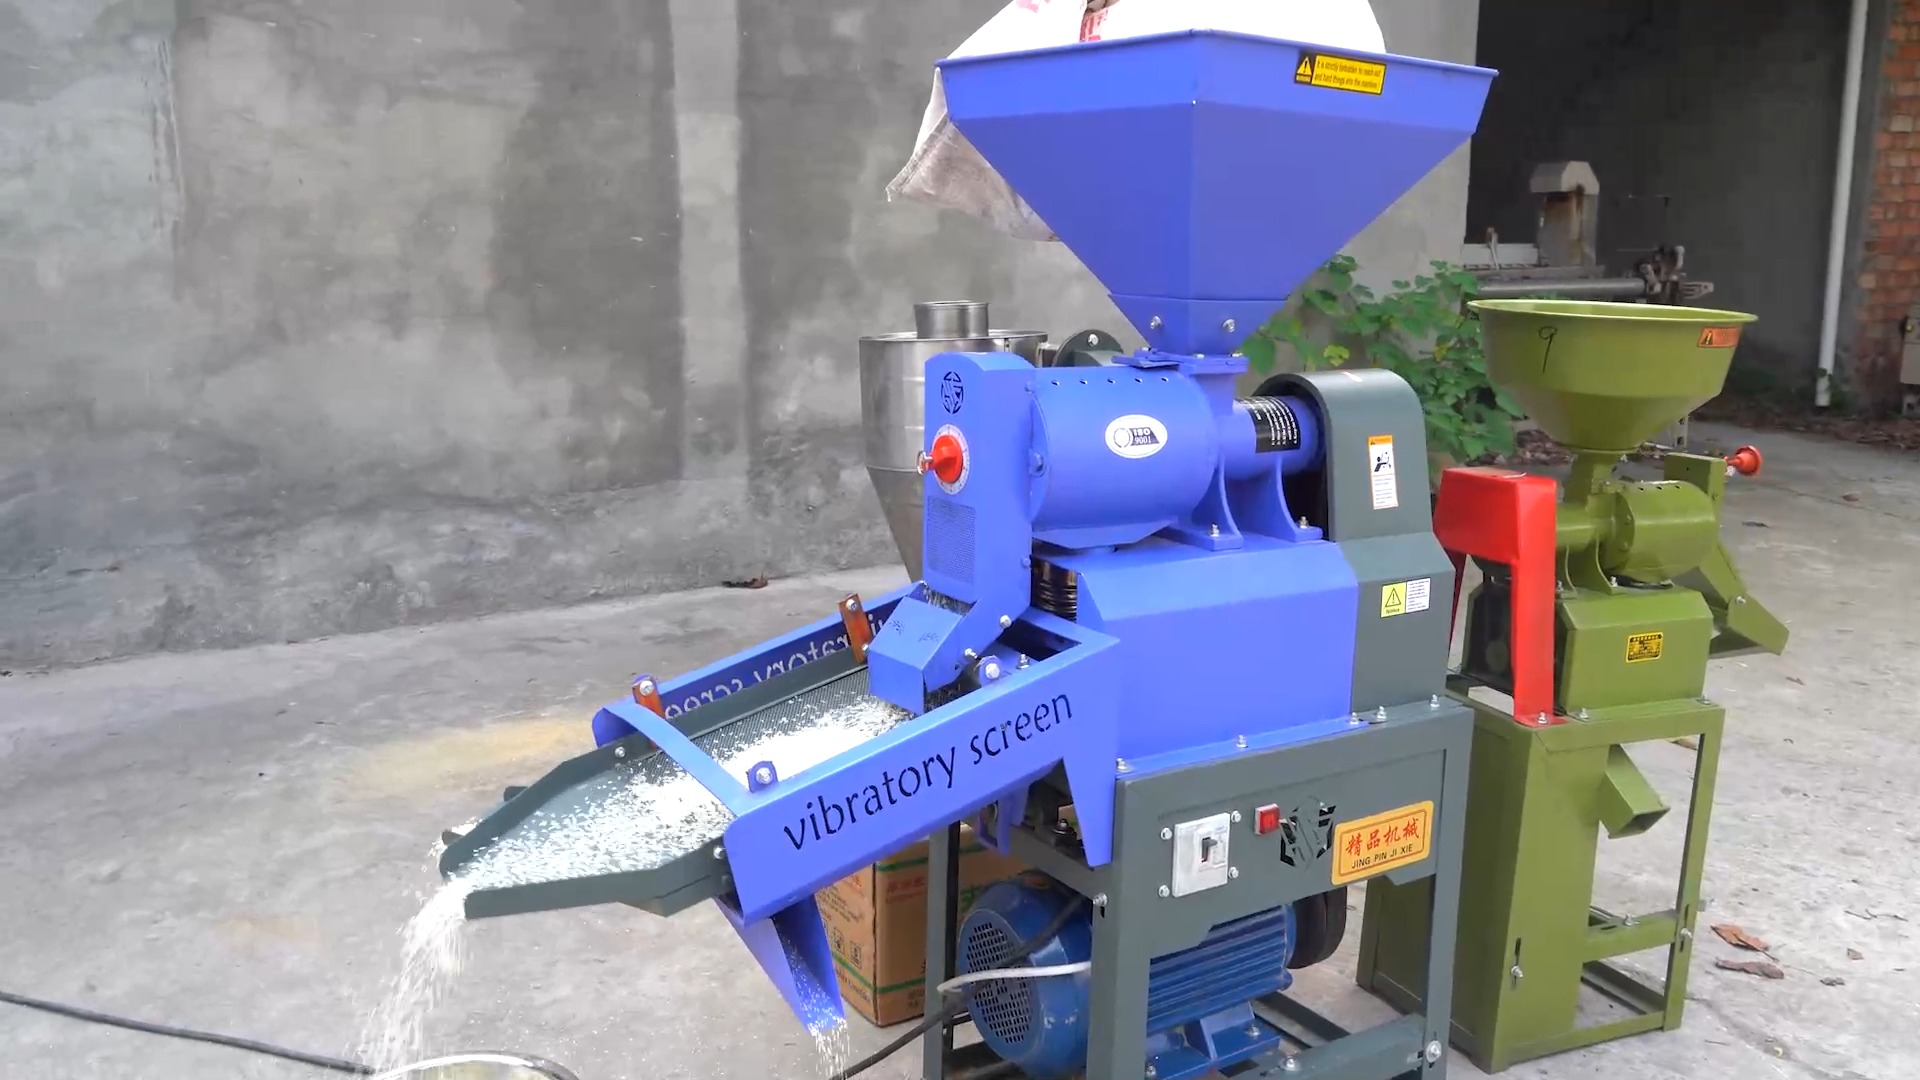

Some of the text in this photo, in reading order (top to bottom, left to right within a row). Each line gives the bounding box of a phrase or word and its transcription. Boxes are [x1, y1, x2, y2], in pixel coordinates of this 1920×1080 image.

[783, 693, 1073, 850] vibratory screen
[1345, 818, 1420, 857] 精品机械
[1352, 843, 1413, 869] JING PIN JI XIE
